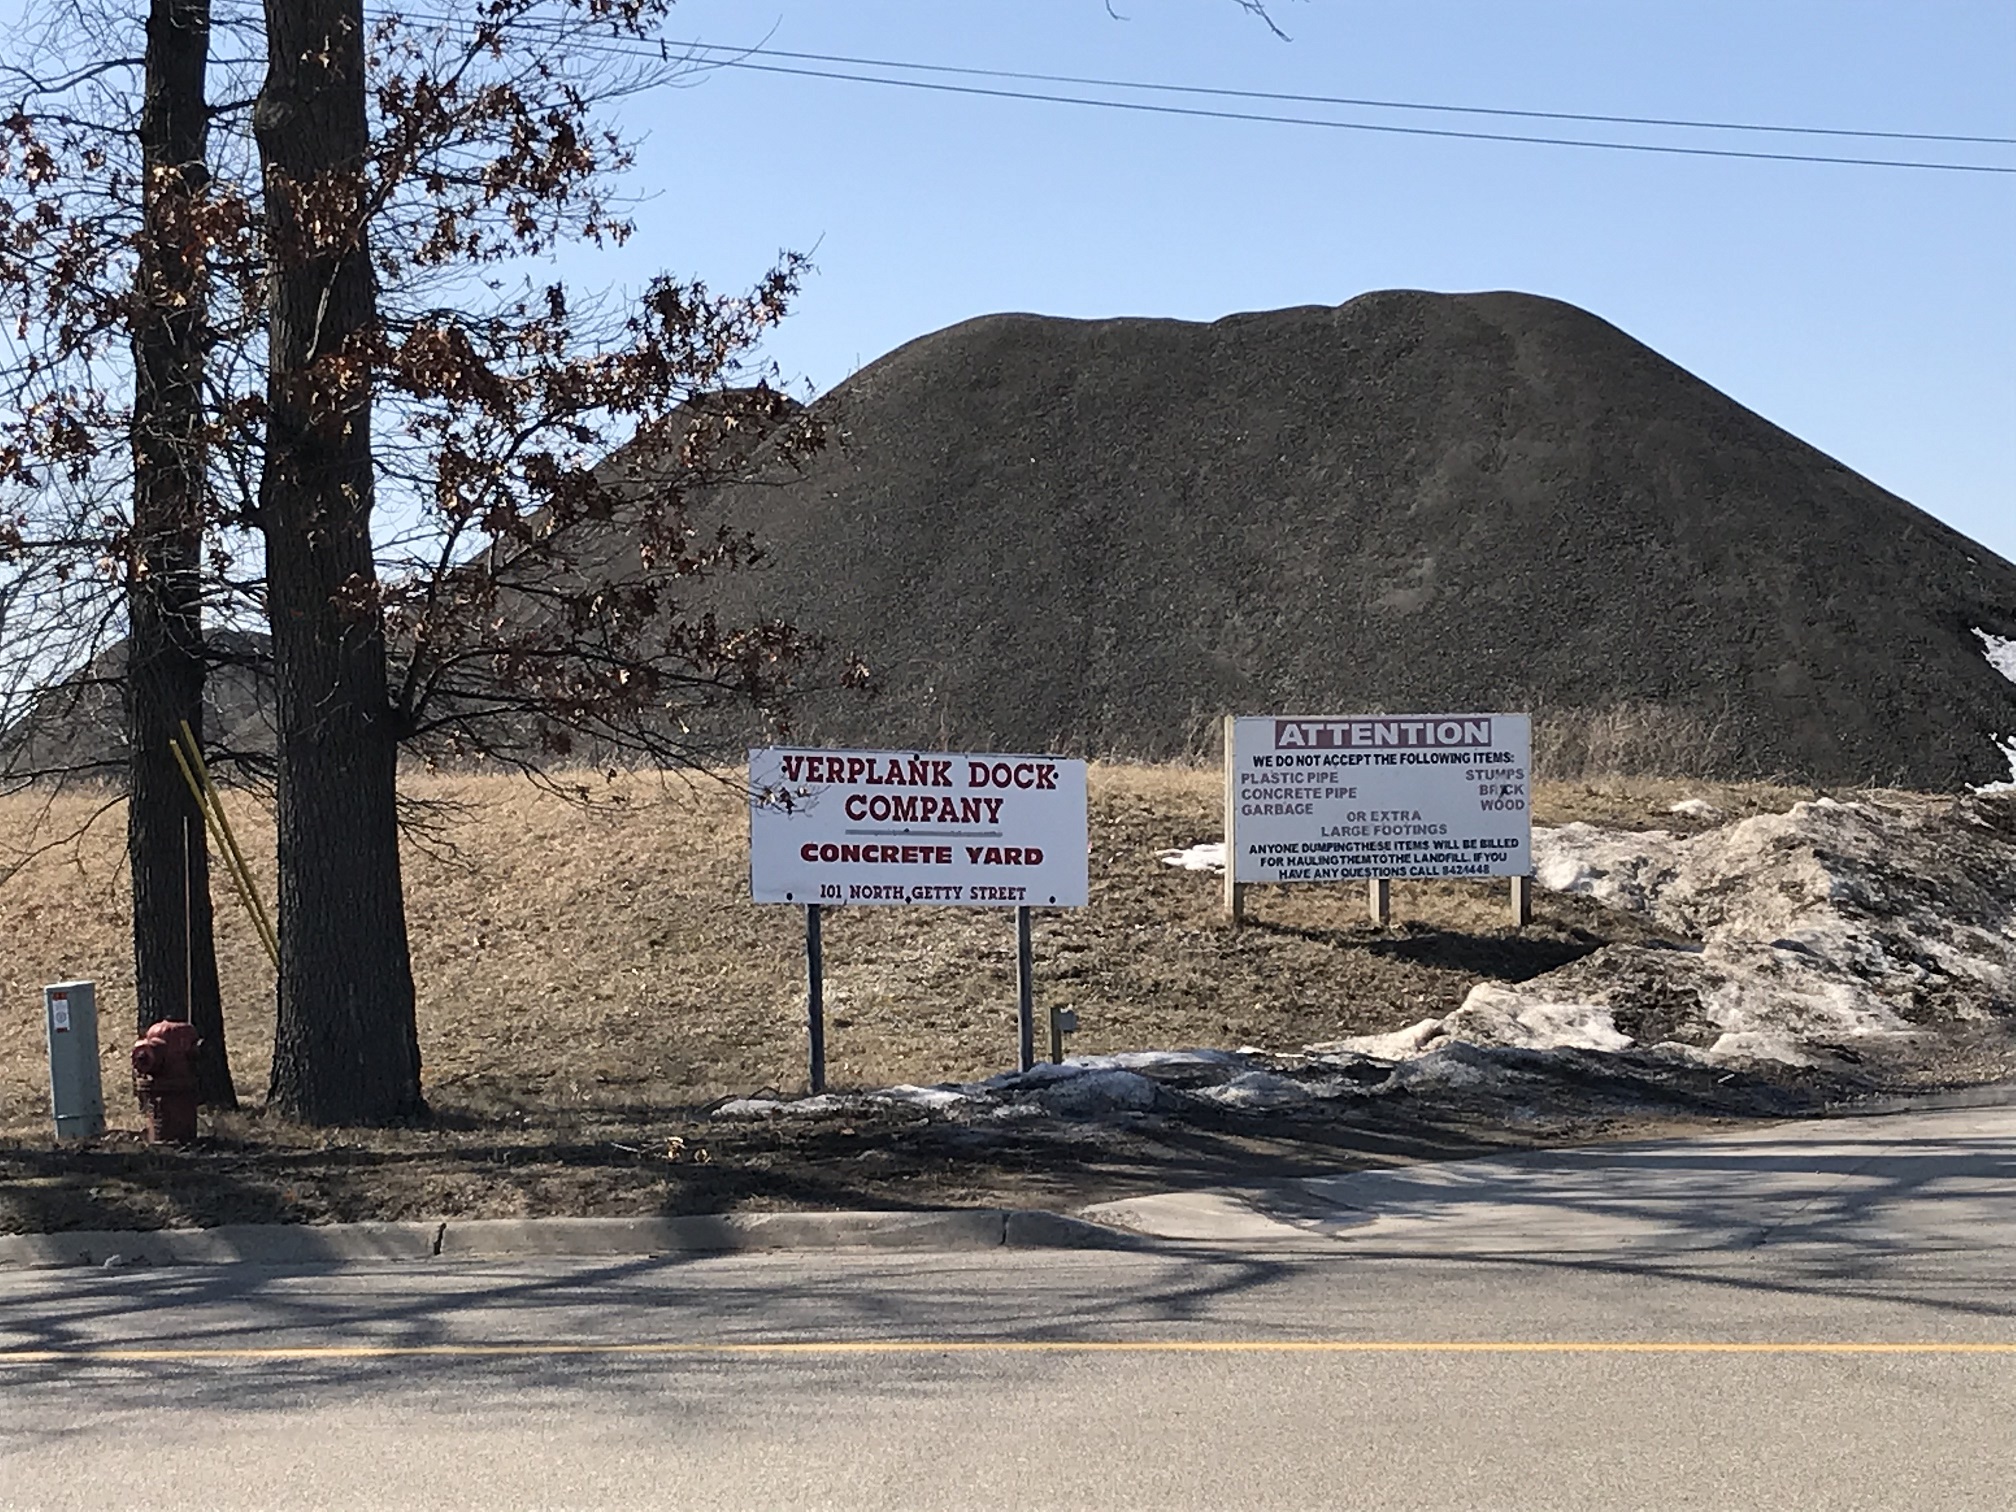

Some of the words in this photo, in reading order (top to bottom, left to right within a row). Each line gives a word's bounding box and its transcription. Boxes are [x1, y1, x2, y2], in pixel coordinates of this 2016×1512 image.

[1279, 721, 1489, 746] ATTENTION
[1253, 756, 1272, 767] WE
[1276, 755, 1293, 767] DO
[1296, 755, 1321, 766] NOT
[1323, 754, 1372, 765] ACCEPT
[1373, 754, 1397, 765] THE
[1400, 753, 1471, 764] FOLLOWING
[1473, 752, 1515, 764] ITEMS:
[783, 756, 952, 787] VERPLANK
[969, 762, 1057, 789] DOCK
[1241, 772, 1304, 784] PLASTIC
[1307, 772, 1338, 783] PIPE
[1242, 788, 1322, 800] CONCRETE
[1325, 787, 1357, 799] PIPE
[845, 795, 1004, 823] COMPANY
[1241, 804, 1313, 815] GARBAGE
[1481, 800, 1524, 811] WOOD
[1346, 811, 1368, 822] OR
[1371, 811, 1421, 821] EXTRA
[1321, 826, 1370, 837] LARGE
[1373, 824, 1448, 836] FOOTINGS
[1249, 843, 1299, 854] ANYONE
[1394, 840, 1429, 851] ITEMS
[1433, 839, 1459, 850] WILL
[1463, 839, 1476, 850] BE
[1480, 838, 1519, 849] BILLED
[801, 843, 952, 864] CONCRETE
[966, 847, 1044, 865] YARD
[1260, 857, 1285, 867] FOR
[1279, 869, 1310, 880] HAVE
[1313, 868, 1340, 879] ANY
[1341, 867, 1406, 878] QUESTIONS
[1409, 866, 1439, 876] CALL
[820, 884, 842, 898] 101
[850, 885, 904, 900] NORTH
[912, 886, 963, 900] GETTY
[970, 887, 1026, 901] STREET
